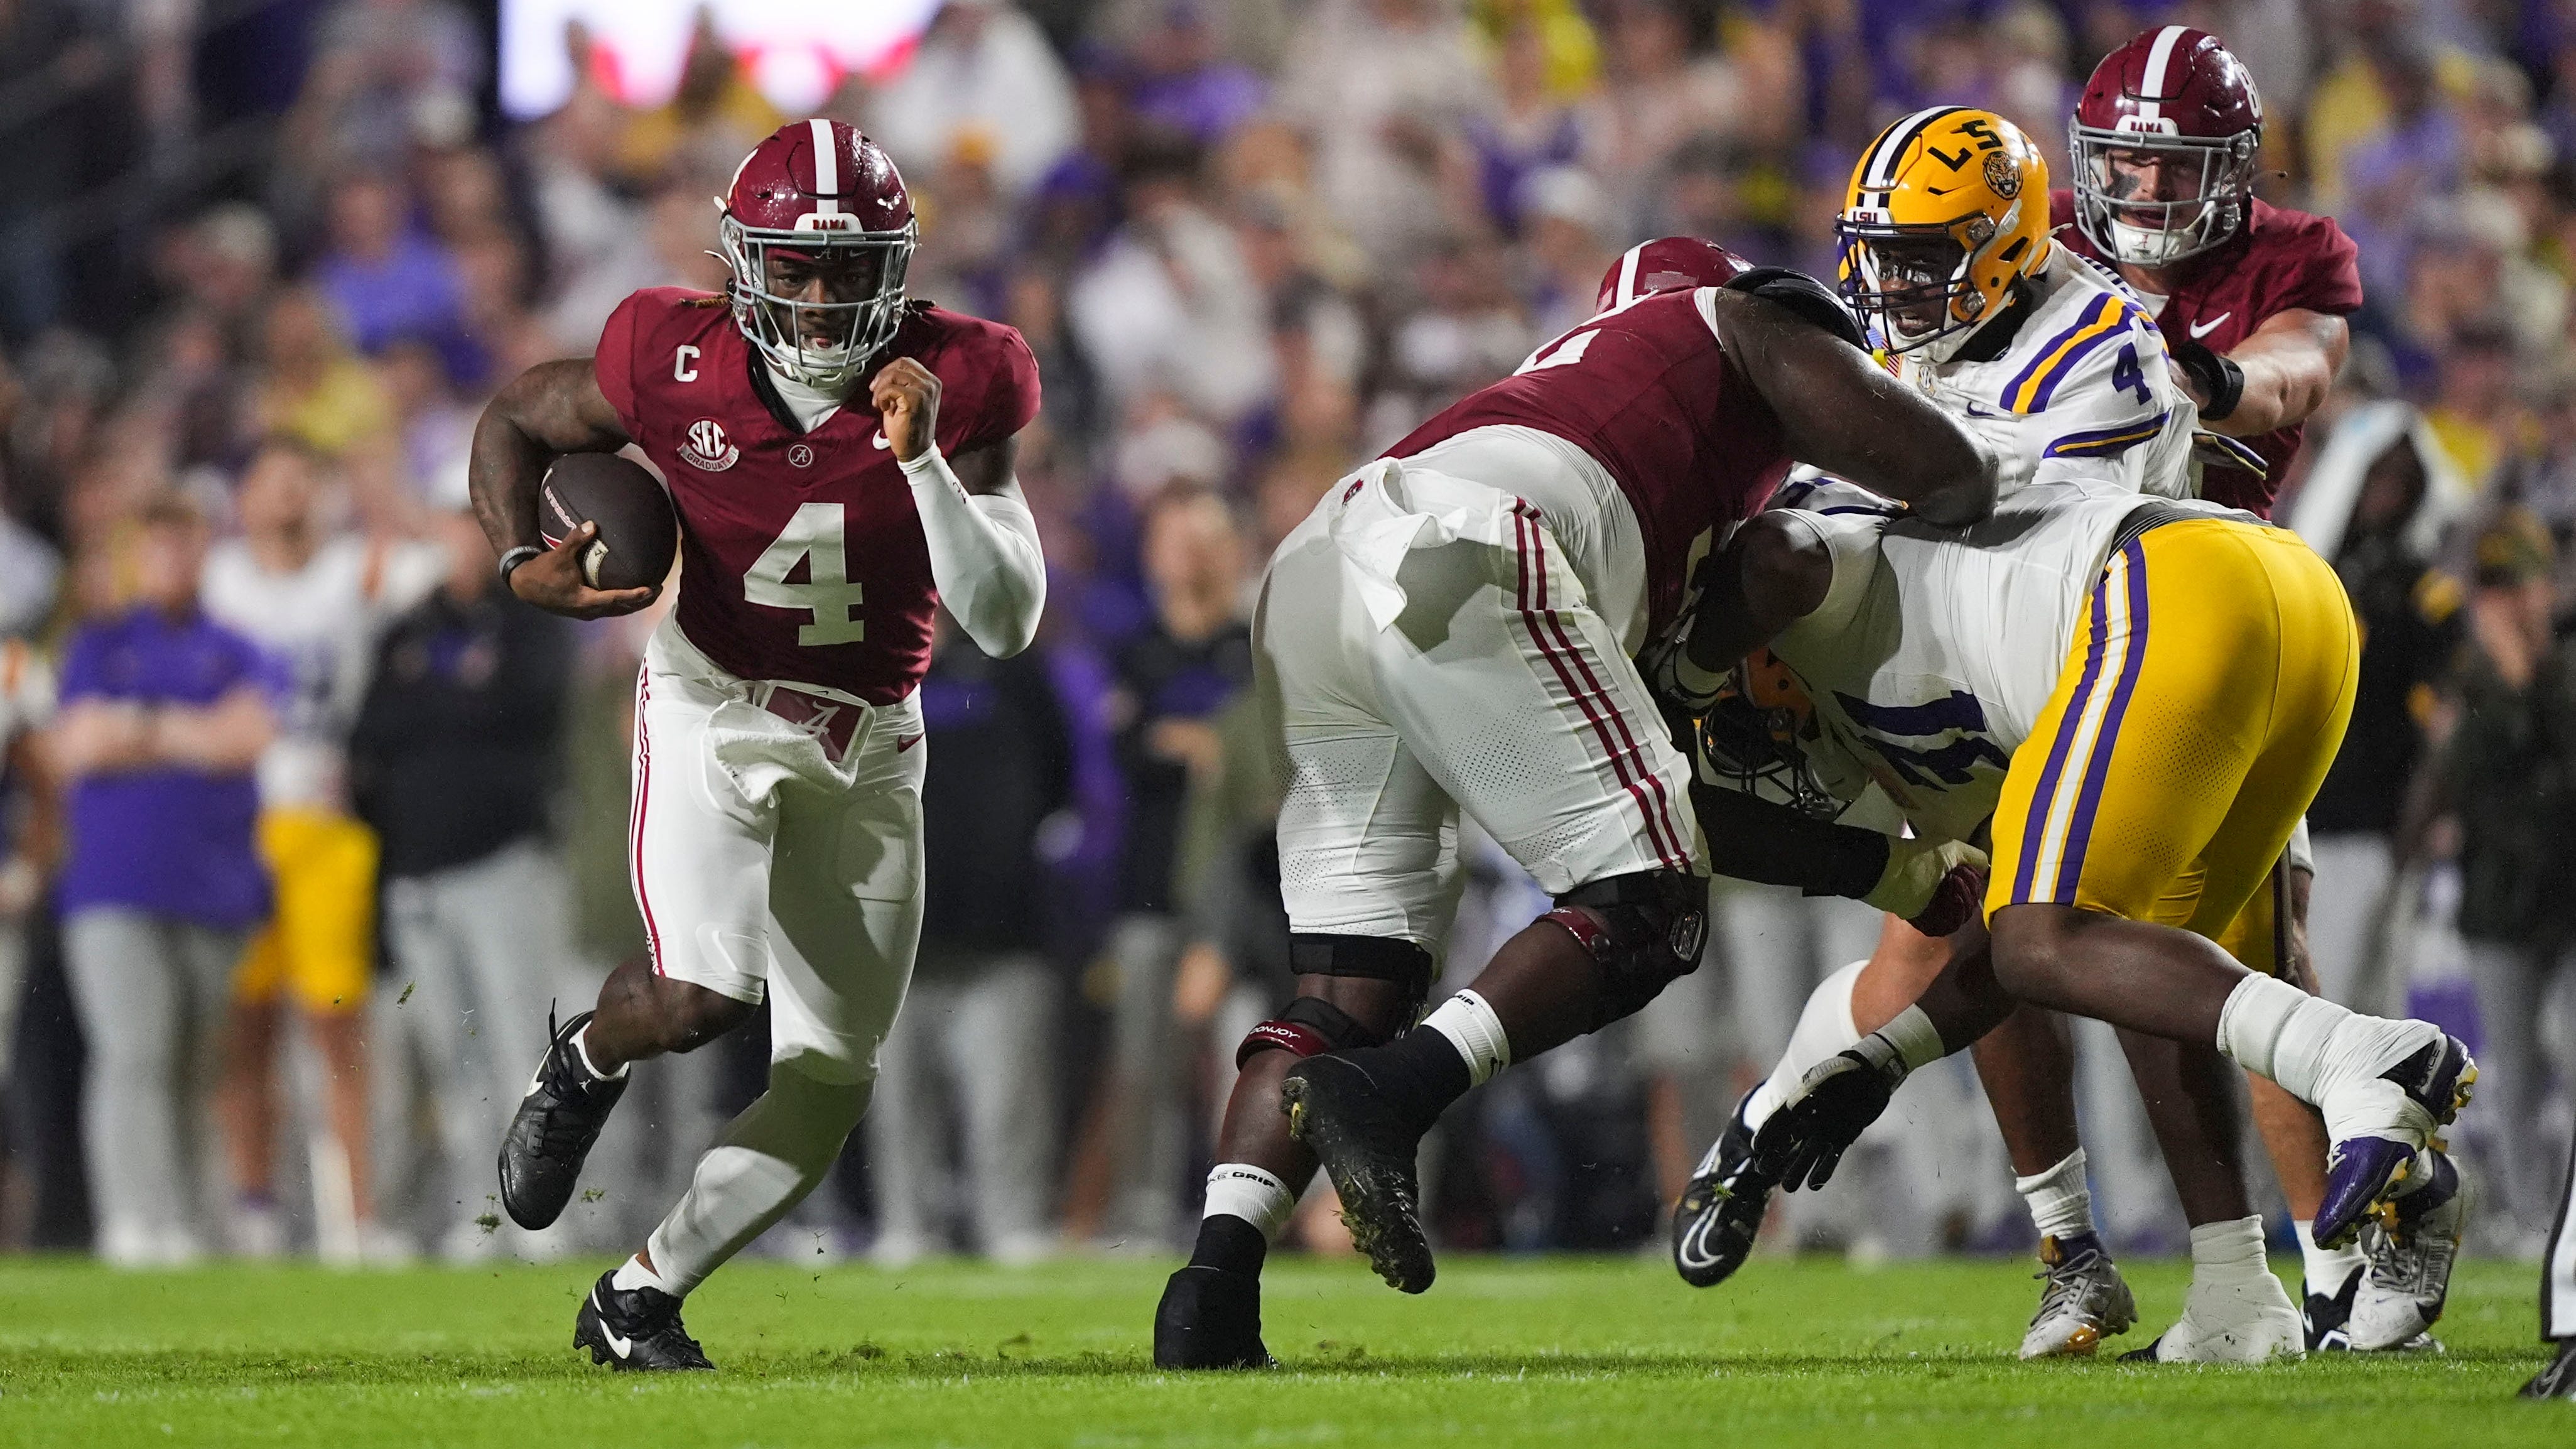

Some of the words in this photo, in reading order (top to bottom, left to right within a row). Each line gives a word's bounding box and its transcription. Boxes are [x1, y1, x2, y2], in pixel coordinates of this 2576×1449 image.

[1927, 119, 2031, 172] LS
[813, 219, 847, 230] BAMA
[1853, 211, 1878, 224] LSU
[674, 345, 700, 382] C
[2112, 342, 2153, 406] 4
[688, 420, 726, 458] SEC
[686, 453, 733, 470] GRADUATE
[744, 502, 864, 646] 4
[1232, 1171, 1275, 1188] GRIP
